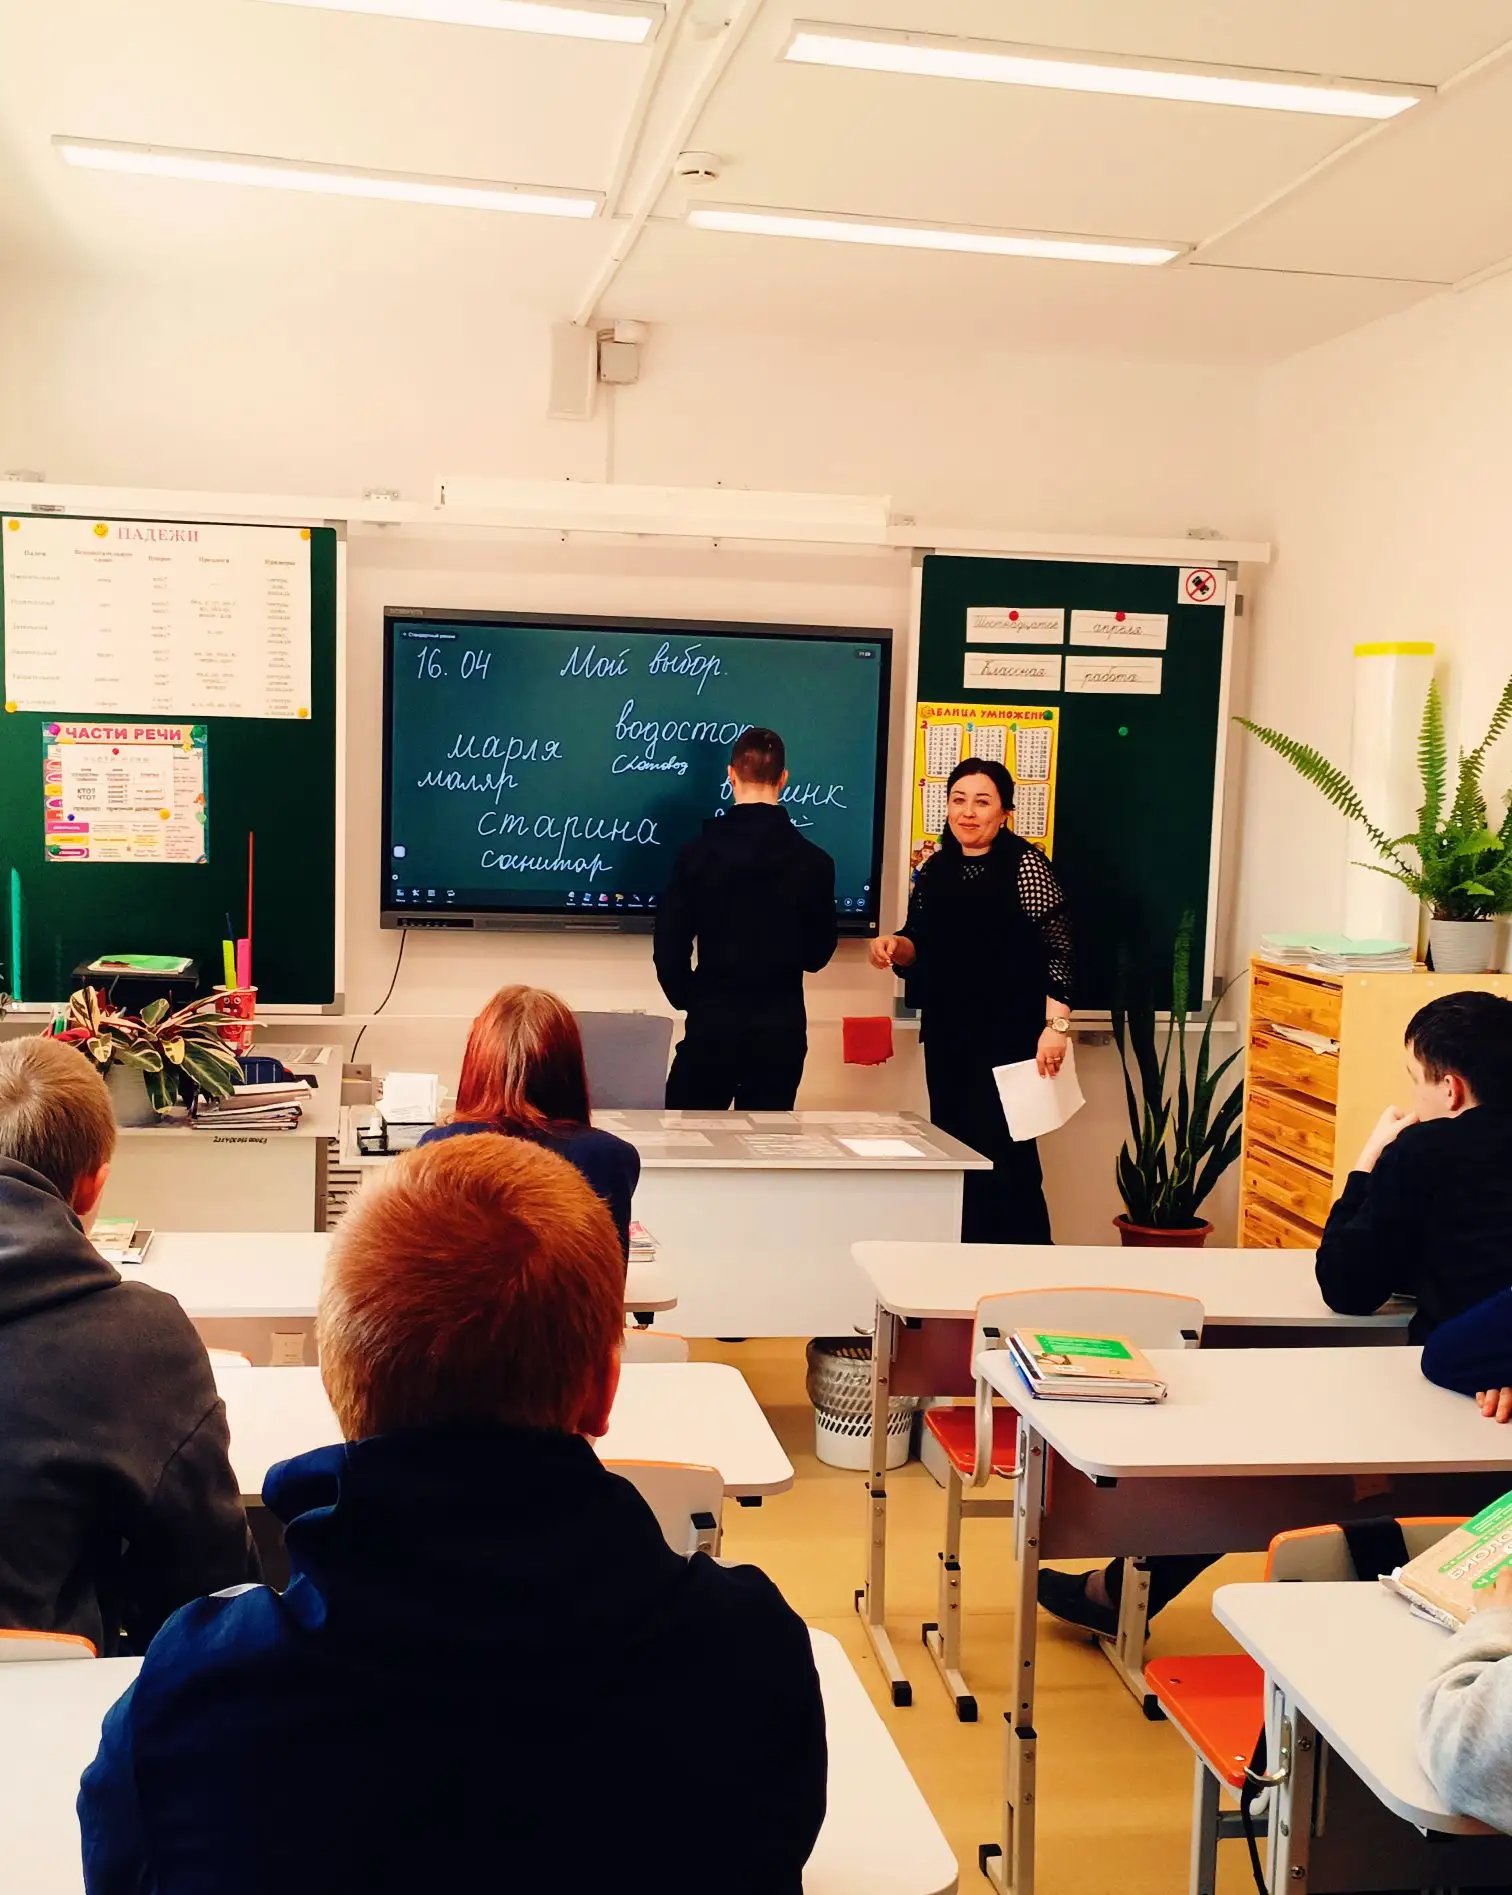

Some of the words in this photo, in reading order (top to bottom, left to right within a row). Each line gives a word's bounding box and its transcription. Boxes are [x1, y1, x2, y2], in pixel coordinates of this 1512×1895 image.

[118, 526, 199, 543] ПАДЕЖИ
[417, 646, 448, 679] 16.
[461, 649, 492, 680] 04
[560, 645, 631, 679] Мой
[1080, 666, 1139, 688] работа
[927, 707, 977, 718] АБЛИЦА
[66, 727, 128, 740] ЧАСТИ
[134, 728, 182, 741] РЕЧИ
[447, 733, 563, 776] марля
[417, 768, 519, 805] маляр
[477, 811, 661, 860] старина
